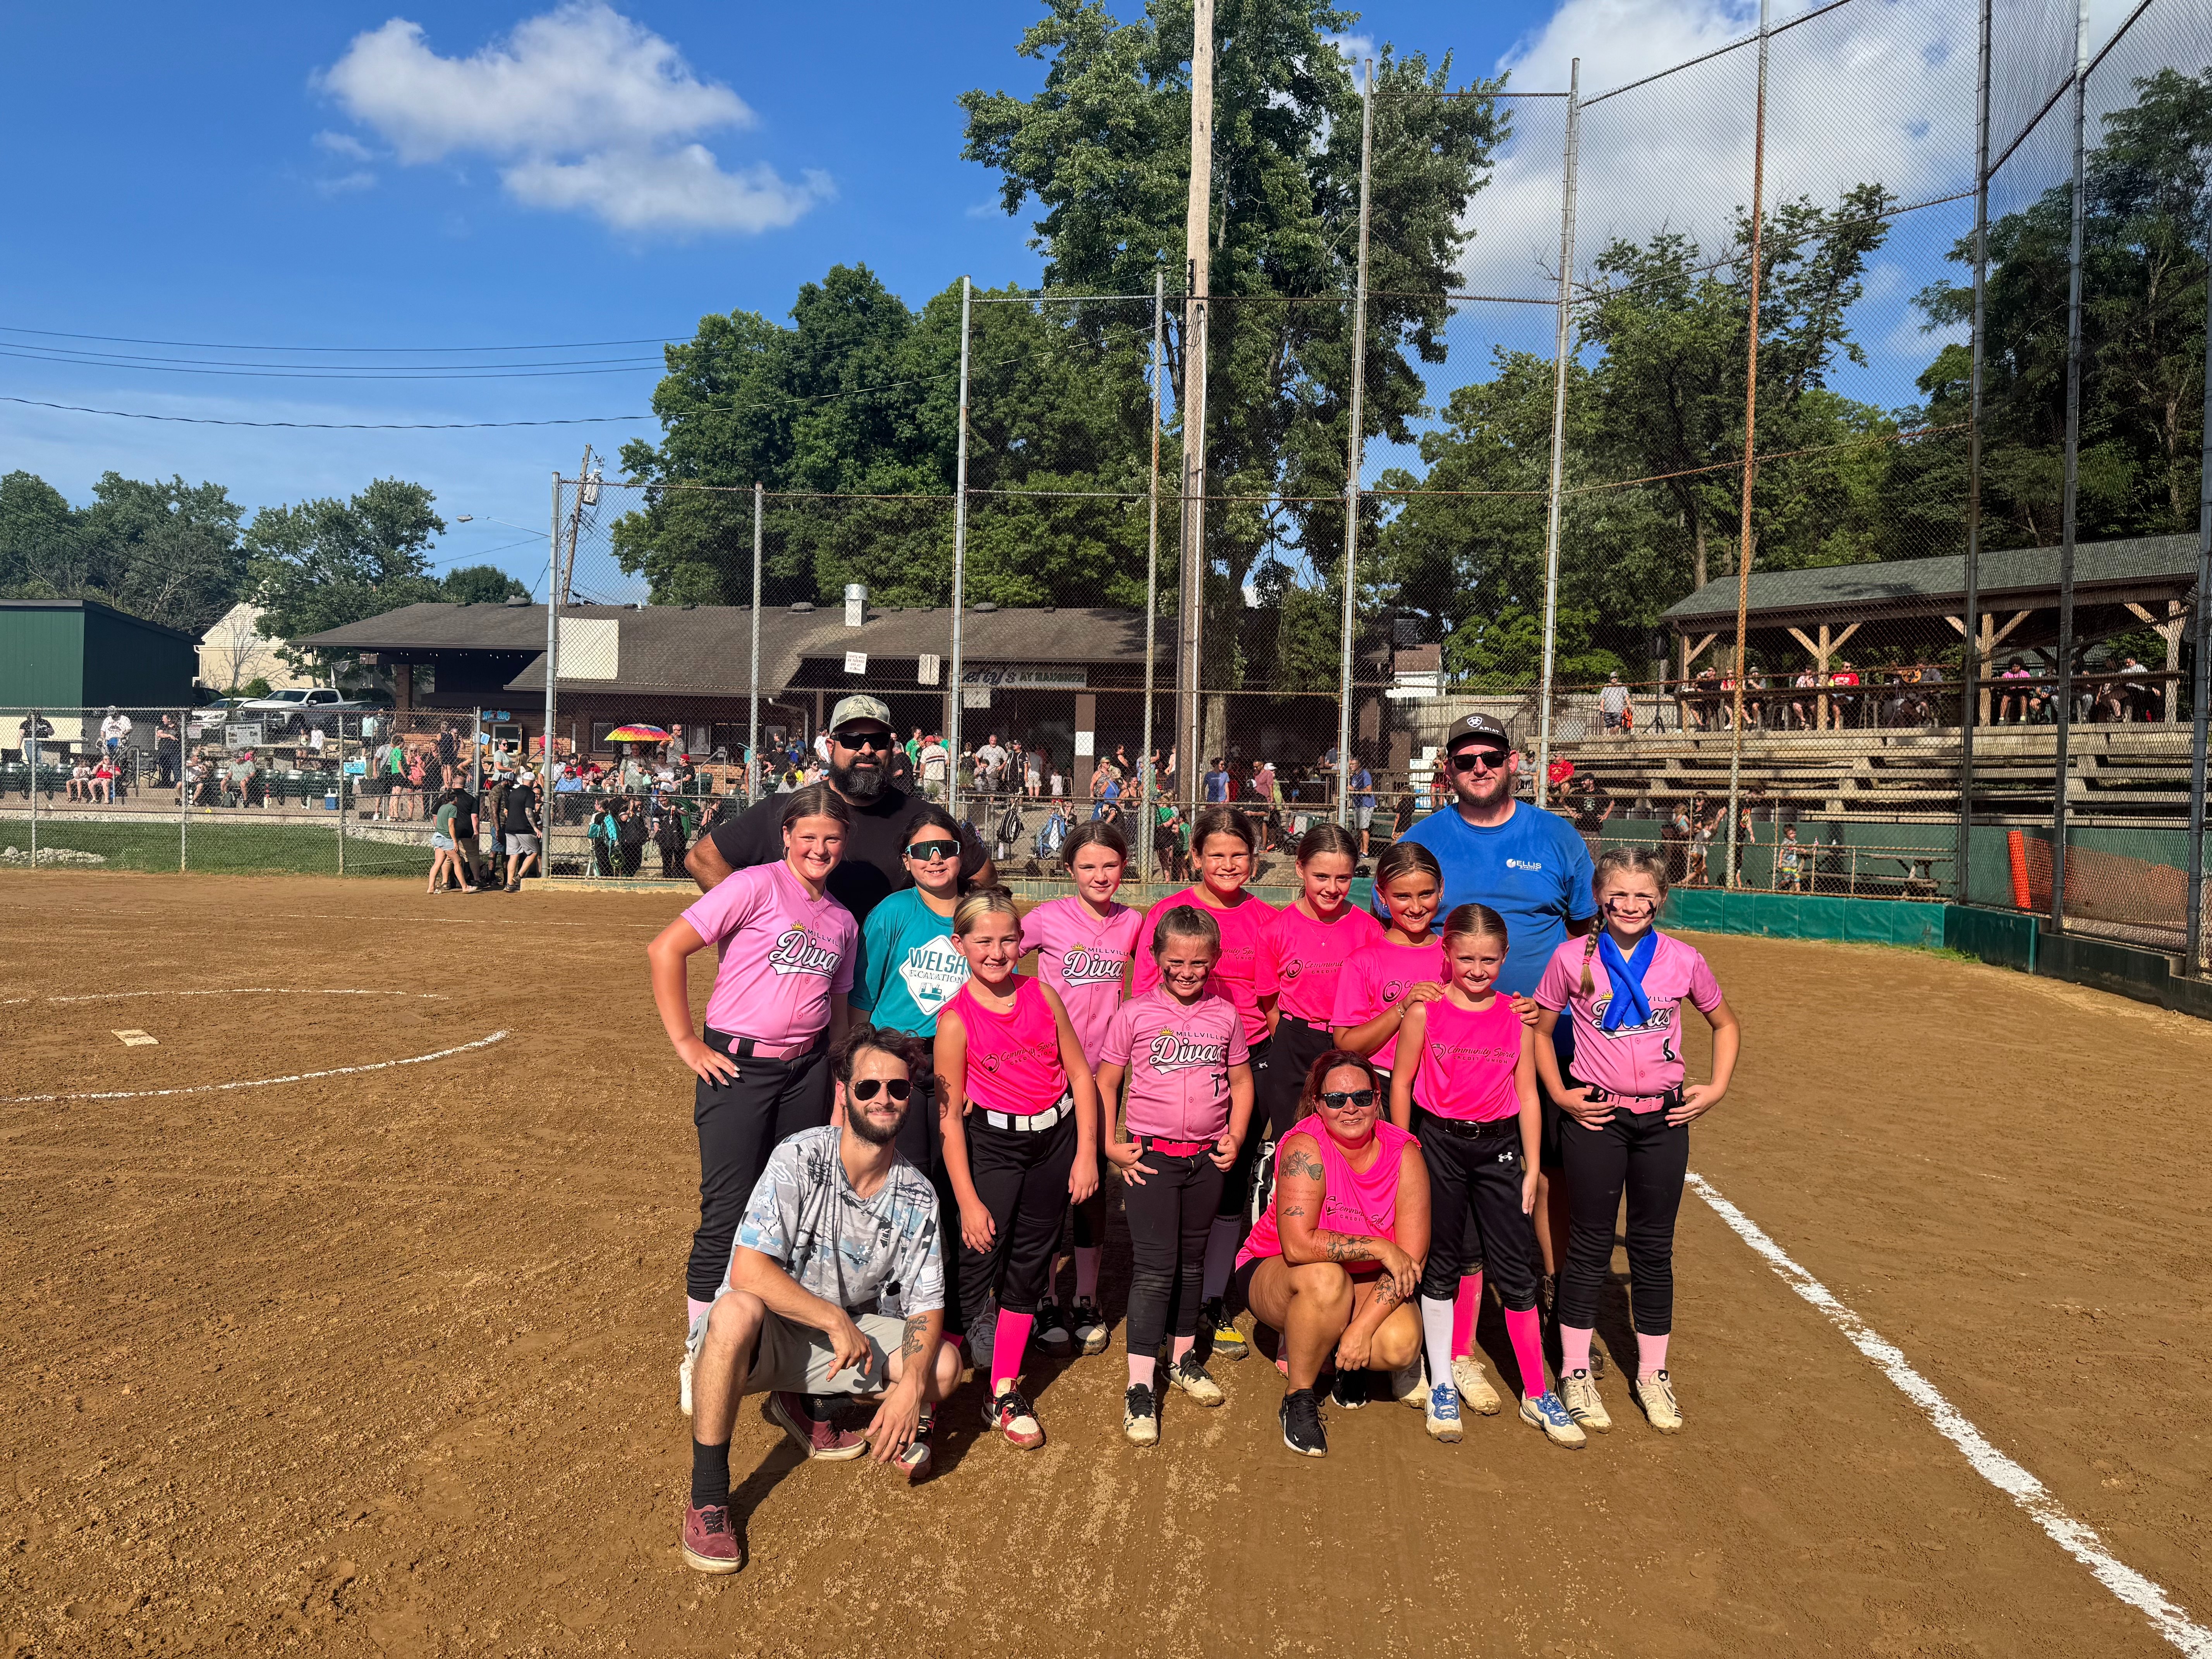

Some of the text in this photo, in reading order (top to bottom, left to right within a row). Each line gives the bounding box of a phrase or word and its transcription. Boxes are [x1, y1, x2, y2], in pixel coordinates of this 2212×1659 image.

[962, 665, 1017, 685] efty's
[1019, 672, 1033, 682] AT
[1516, 860, 1541, 869] ELLIS
[910, 949, 966, 975] WELSH
[1176, 1031, 1224, 1041] MILLVILLE
[1149, 1034, 1224, 1065] Divas
[1448, 1045, 1515, 1058] Community Spirit
[1211, 1073, 1221, 1097] 7
